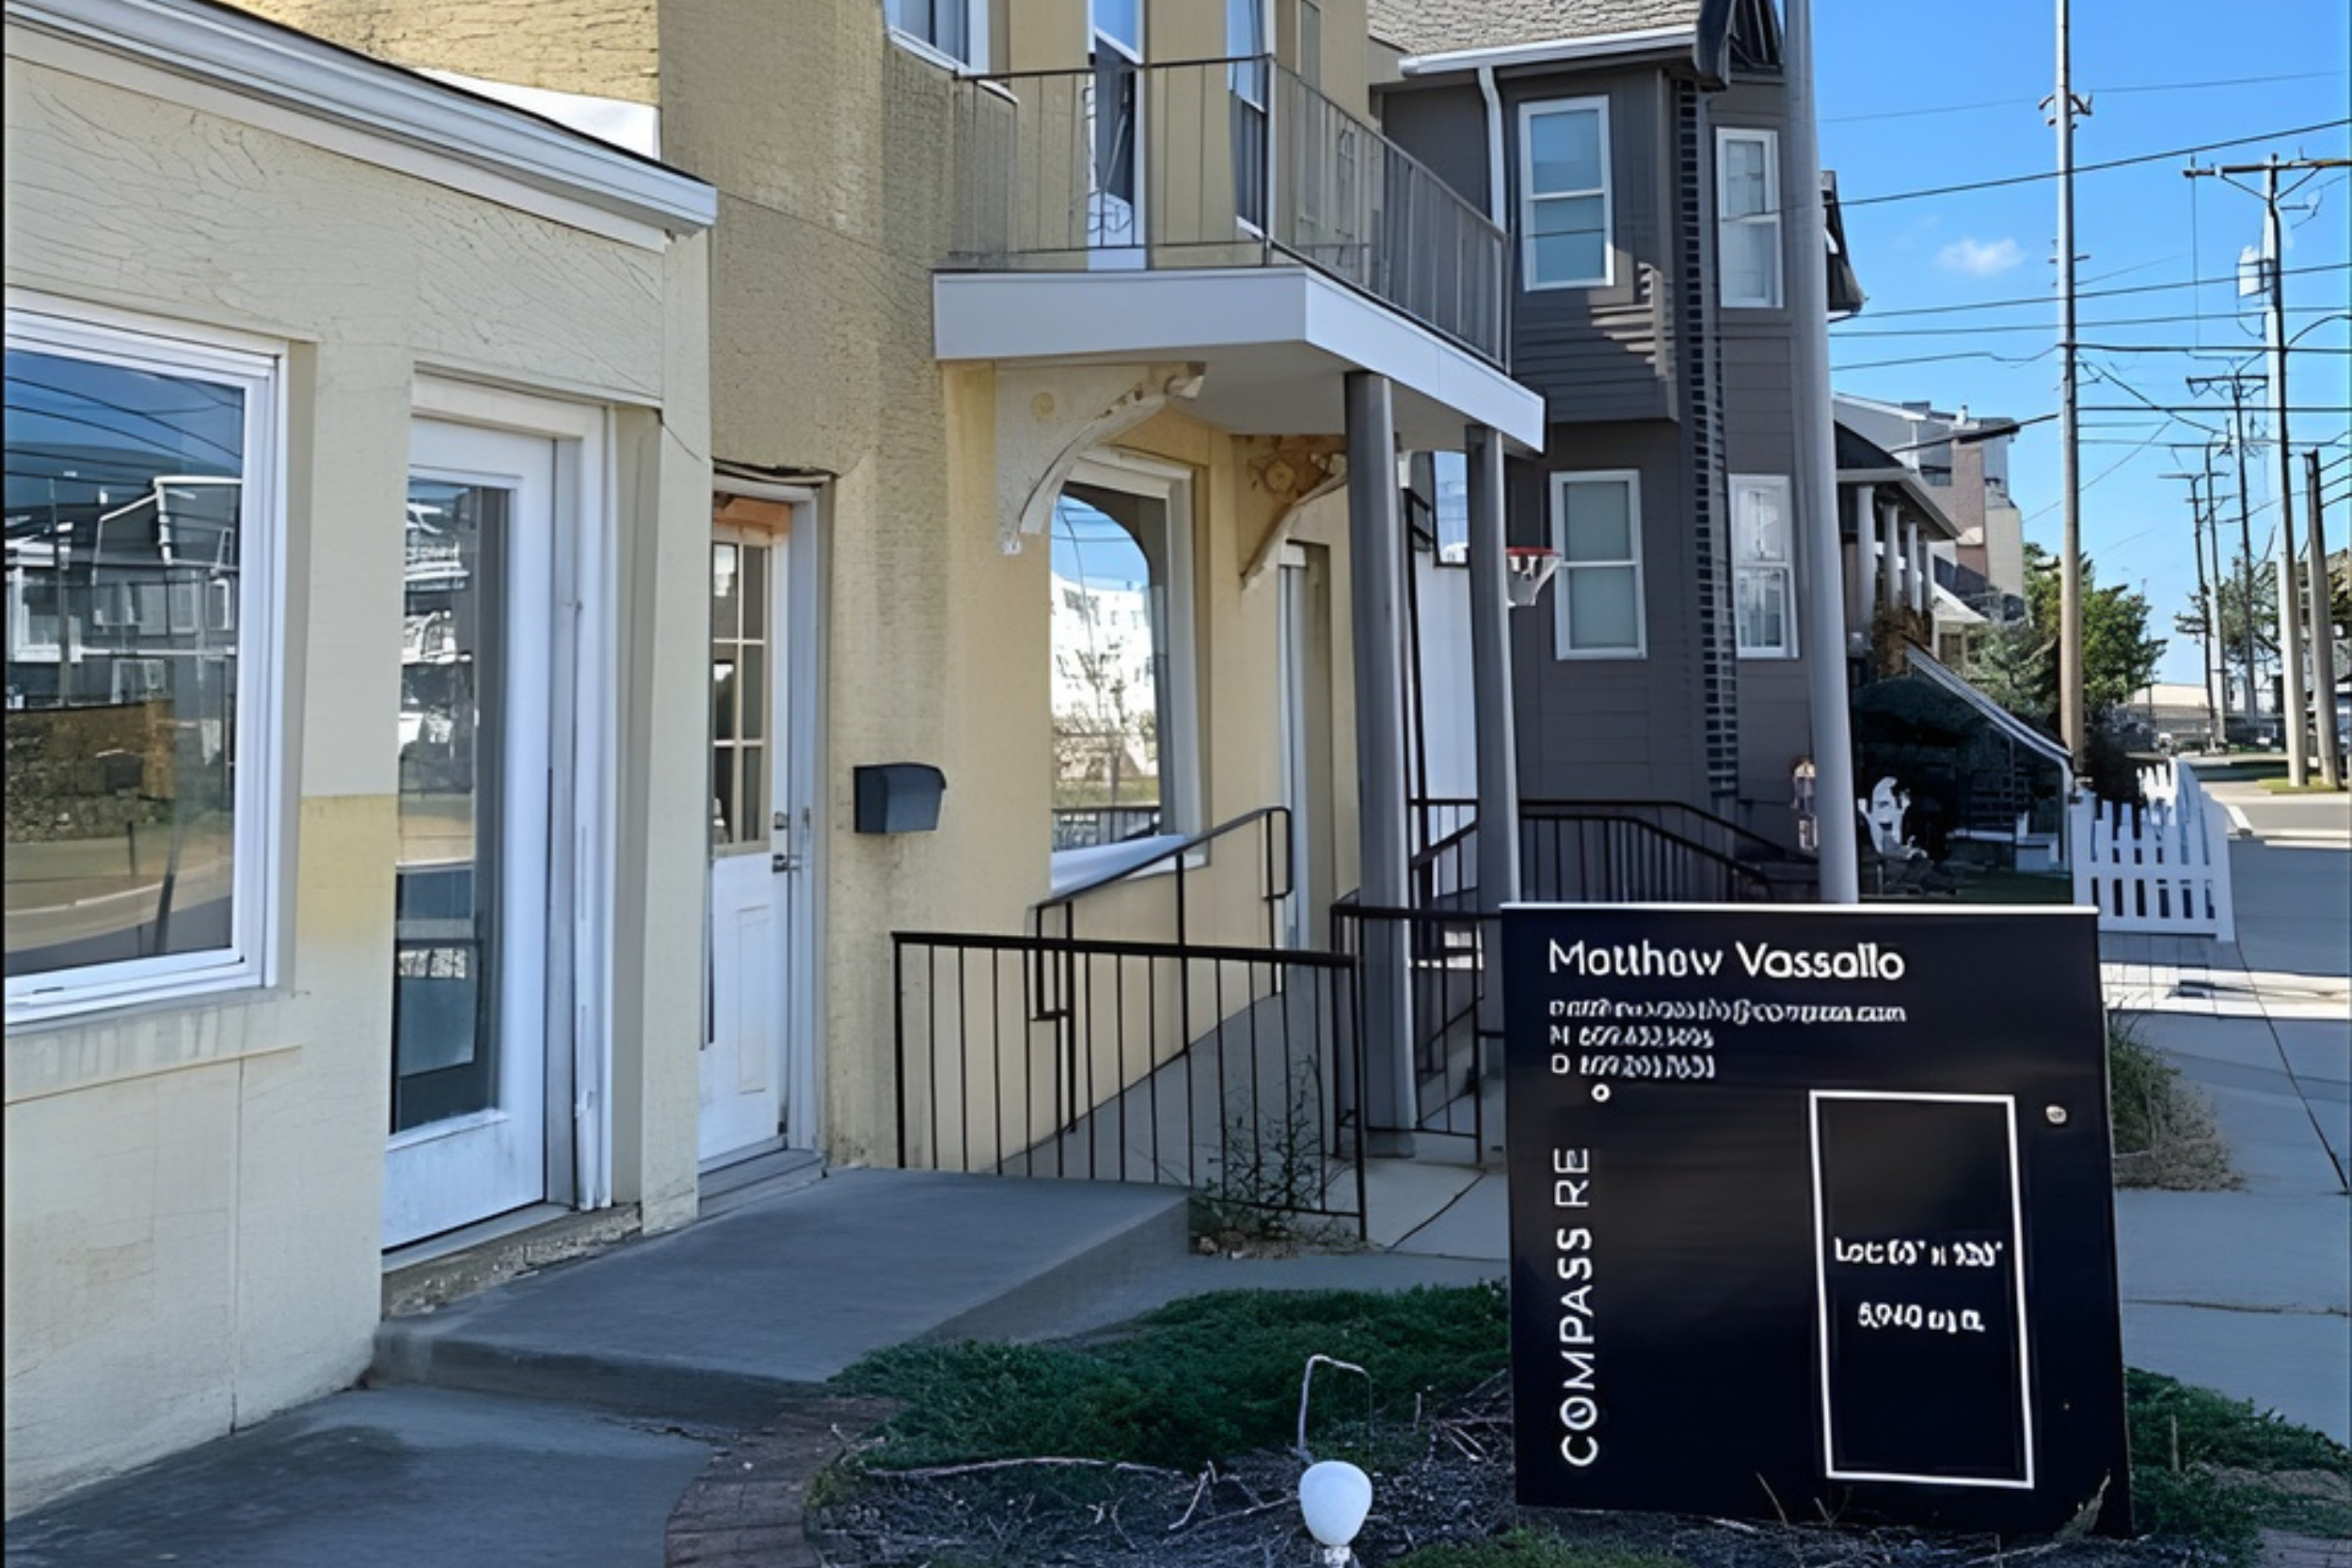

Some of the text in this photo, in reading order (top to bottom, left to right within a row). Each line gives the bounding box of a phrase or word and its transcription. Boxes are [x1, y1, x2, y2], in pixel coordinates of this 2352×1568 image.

[1734, 939, 1907, 981] Vassallo
[1552, 1148, 1599, 1467] COMPASS RE
